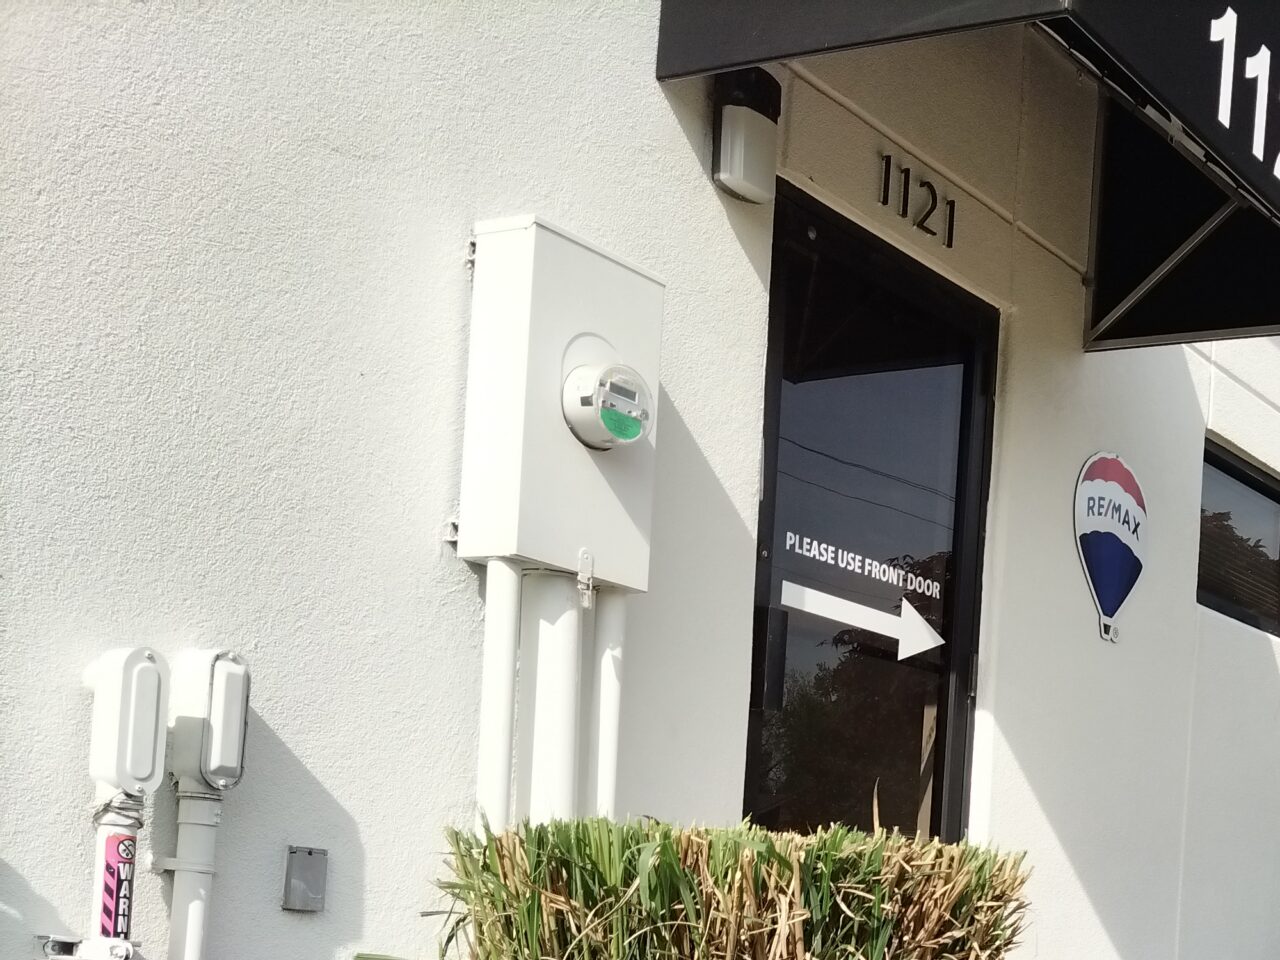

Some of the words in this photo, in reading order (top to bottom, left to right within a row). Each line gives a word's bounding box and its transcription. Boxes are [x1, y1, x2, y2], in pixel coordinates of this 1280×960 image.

[882, 154, 955, 249] 1121
[1087, 496, 1141, 541] RE/MAX
[785, 531, 836, 565] PLEASE
[838, 549, 862, 574] USE
[864, 557, 906, 587] FRONT
[907, 572, 941, 599] DOOR
